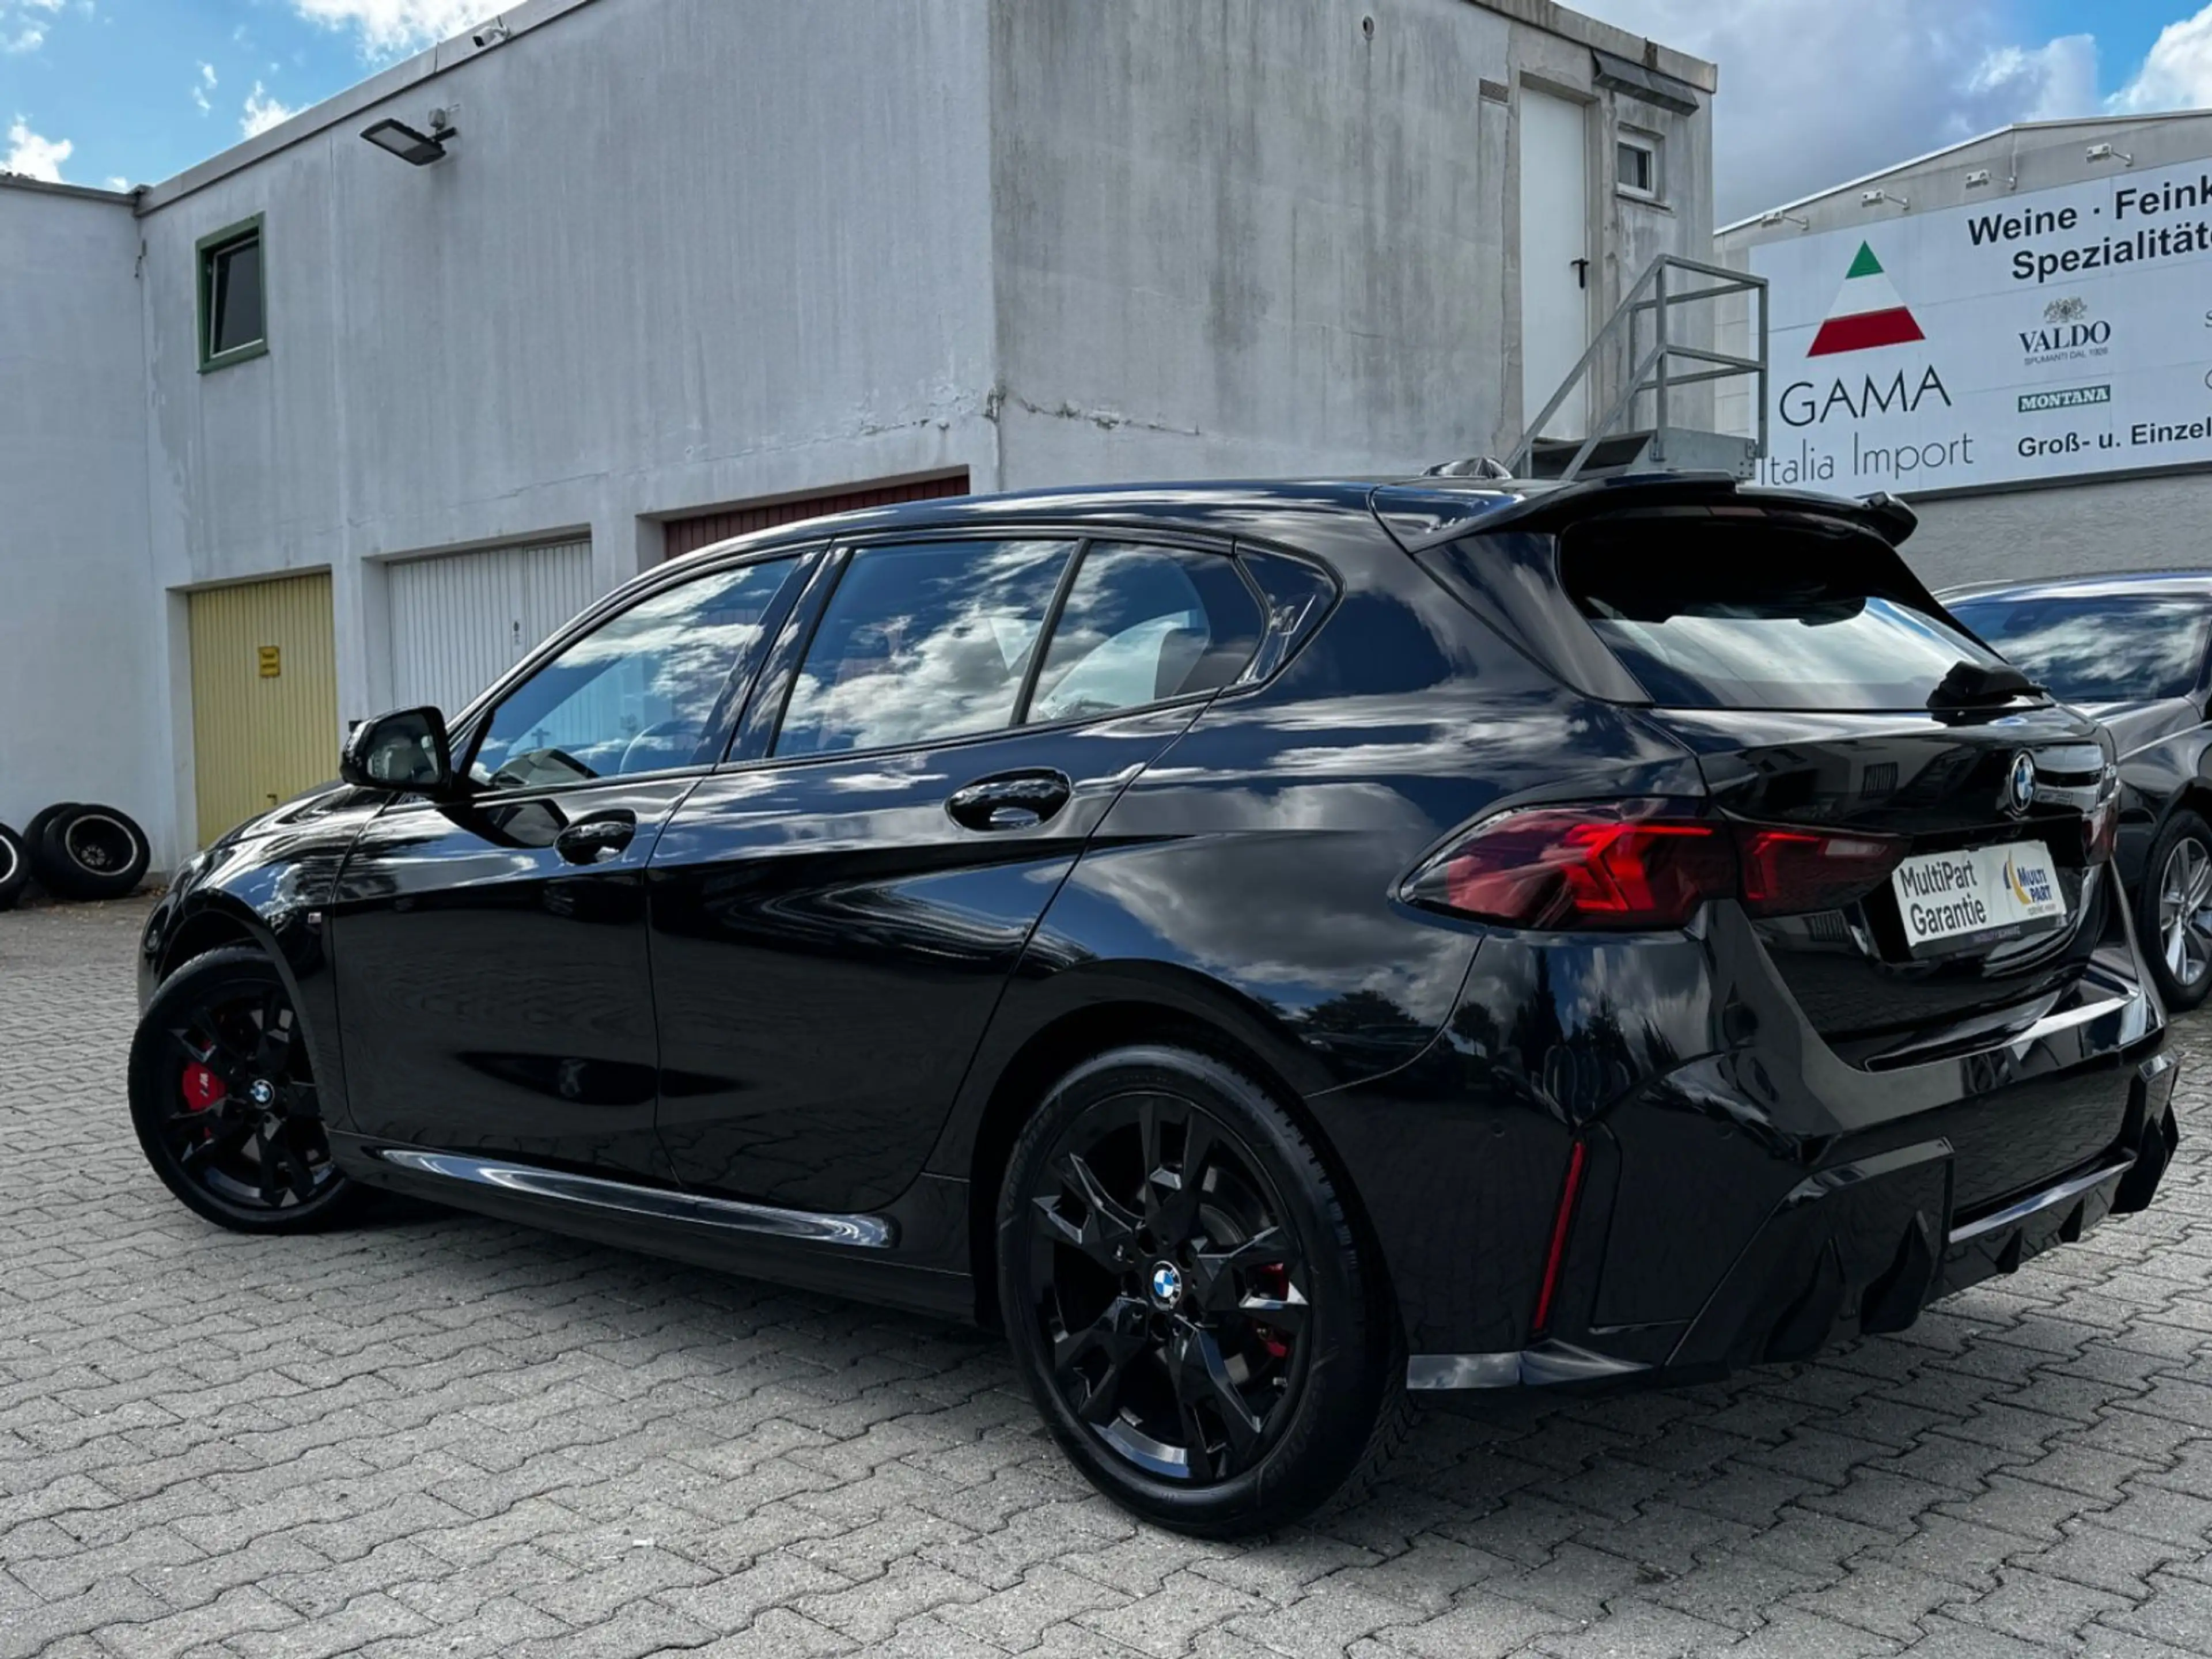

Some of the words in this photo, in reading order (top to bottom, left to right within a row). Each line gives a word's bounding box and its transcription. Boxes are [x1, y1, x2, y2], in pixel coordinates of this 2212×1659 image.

[1968, 208, 2077, 246] Weine
[2012, 221, 2212, 283] Spezialität
[2018, 320, 2111, 354] VALDO
[1779, 364, 1952, 426] GAMA
[2020, 387, 2109, 411] MONTANA
[2018, 431, 2090, 457] Groß-
[2099, 433, 2120, 449] u.
[2131, 416, 2211, 445] Einzel
[1761, 438, 1834, 486] Italia
[1854, 431, 1974, 480] Import
[1899, 859, 1978, 898] MultiPart
[1910, 893, 1987, 936] Garantie
